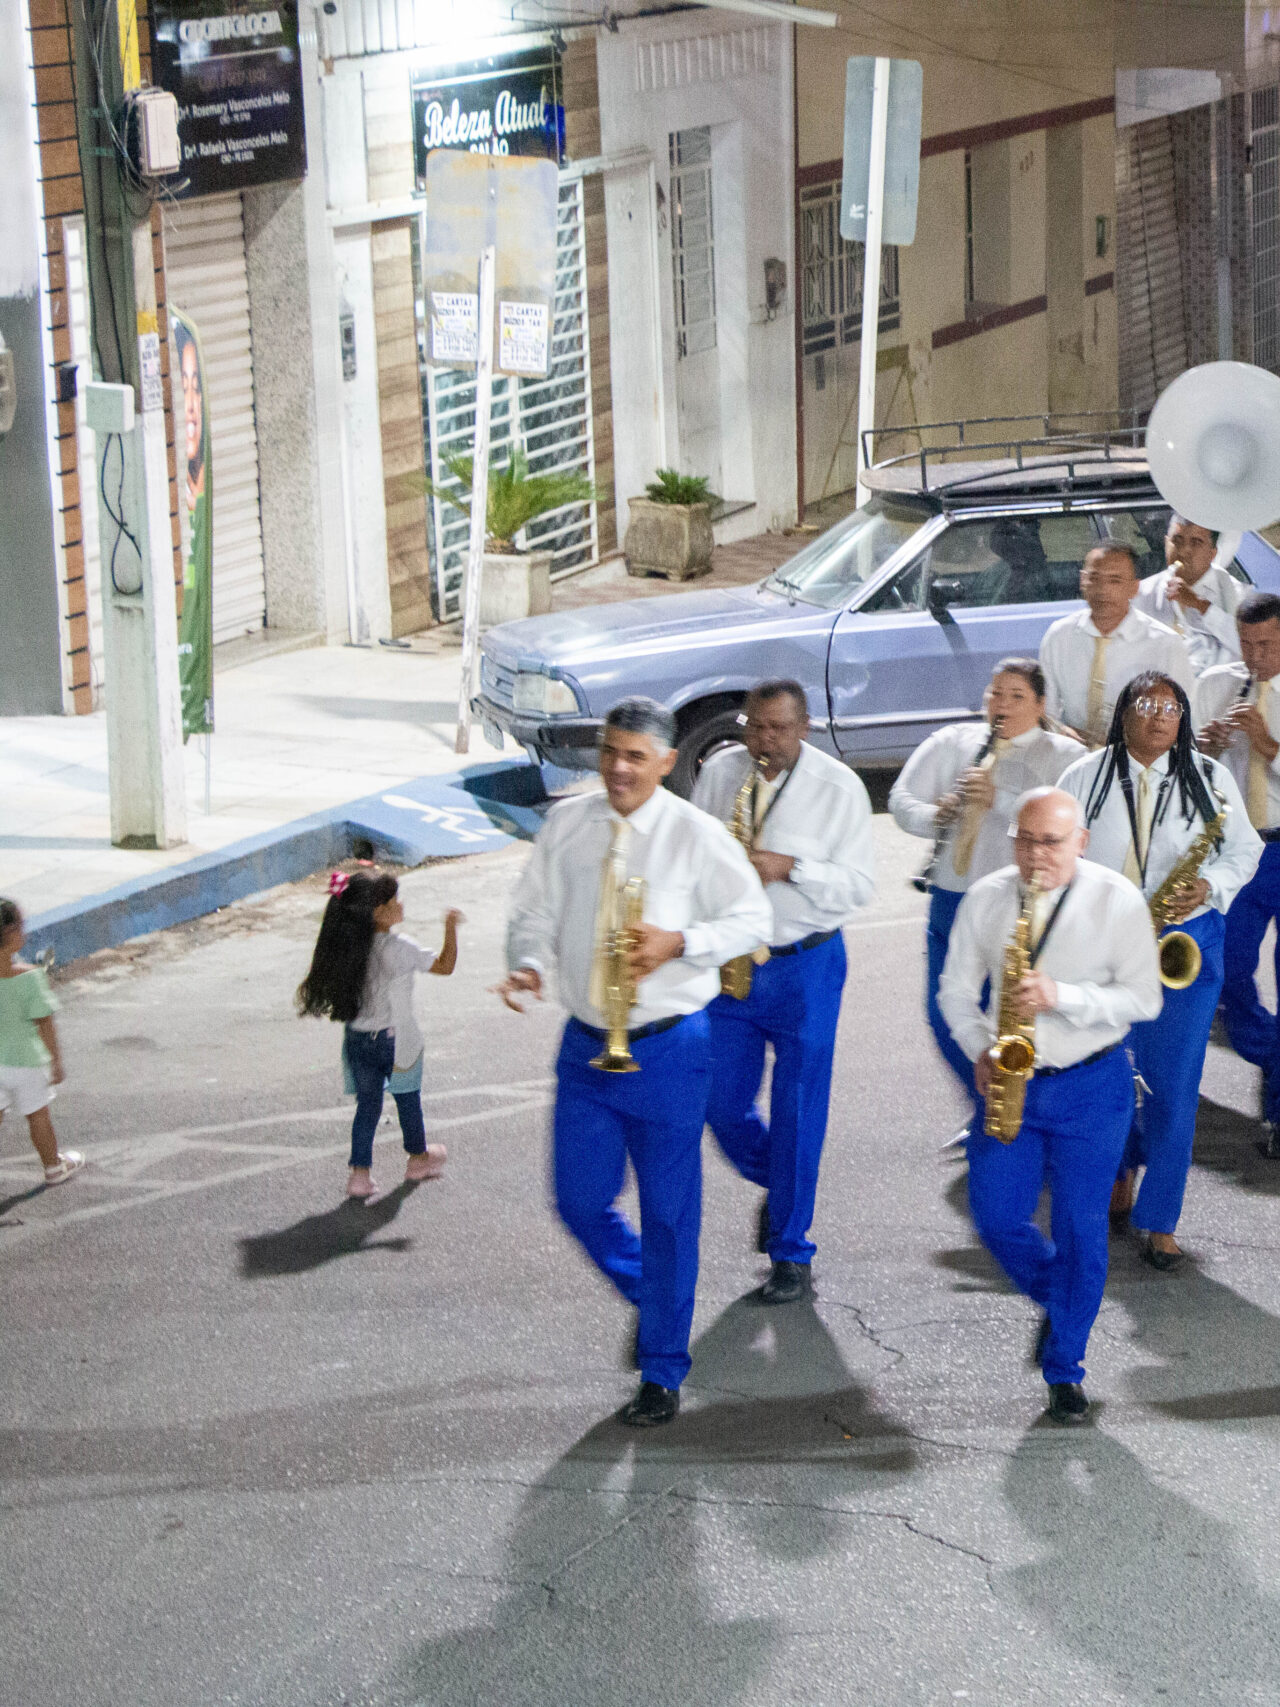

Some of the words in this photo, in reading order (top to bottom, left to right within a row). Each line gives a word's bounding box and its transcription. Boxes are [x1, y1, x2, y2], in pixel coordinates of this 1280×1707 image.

[179, 10, 283, 42] ODONTOLOGIA
[192, 102, 228, 119] Rosemary
[228, 95, 271, 112] Vasconcelos
[272, 90, 290, 105] Melo
[424, 98, 492, 149] Beleza
[495, 84, 548, 136] Atual
[199, 140, 226, 156] Rafaela
[226, 133, 270, 152] Vasconcelos
[270, 129, 288, 145] Melo
